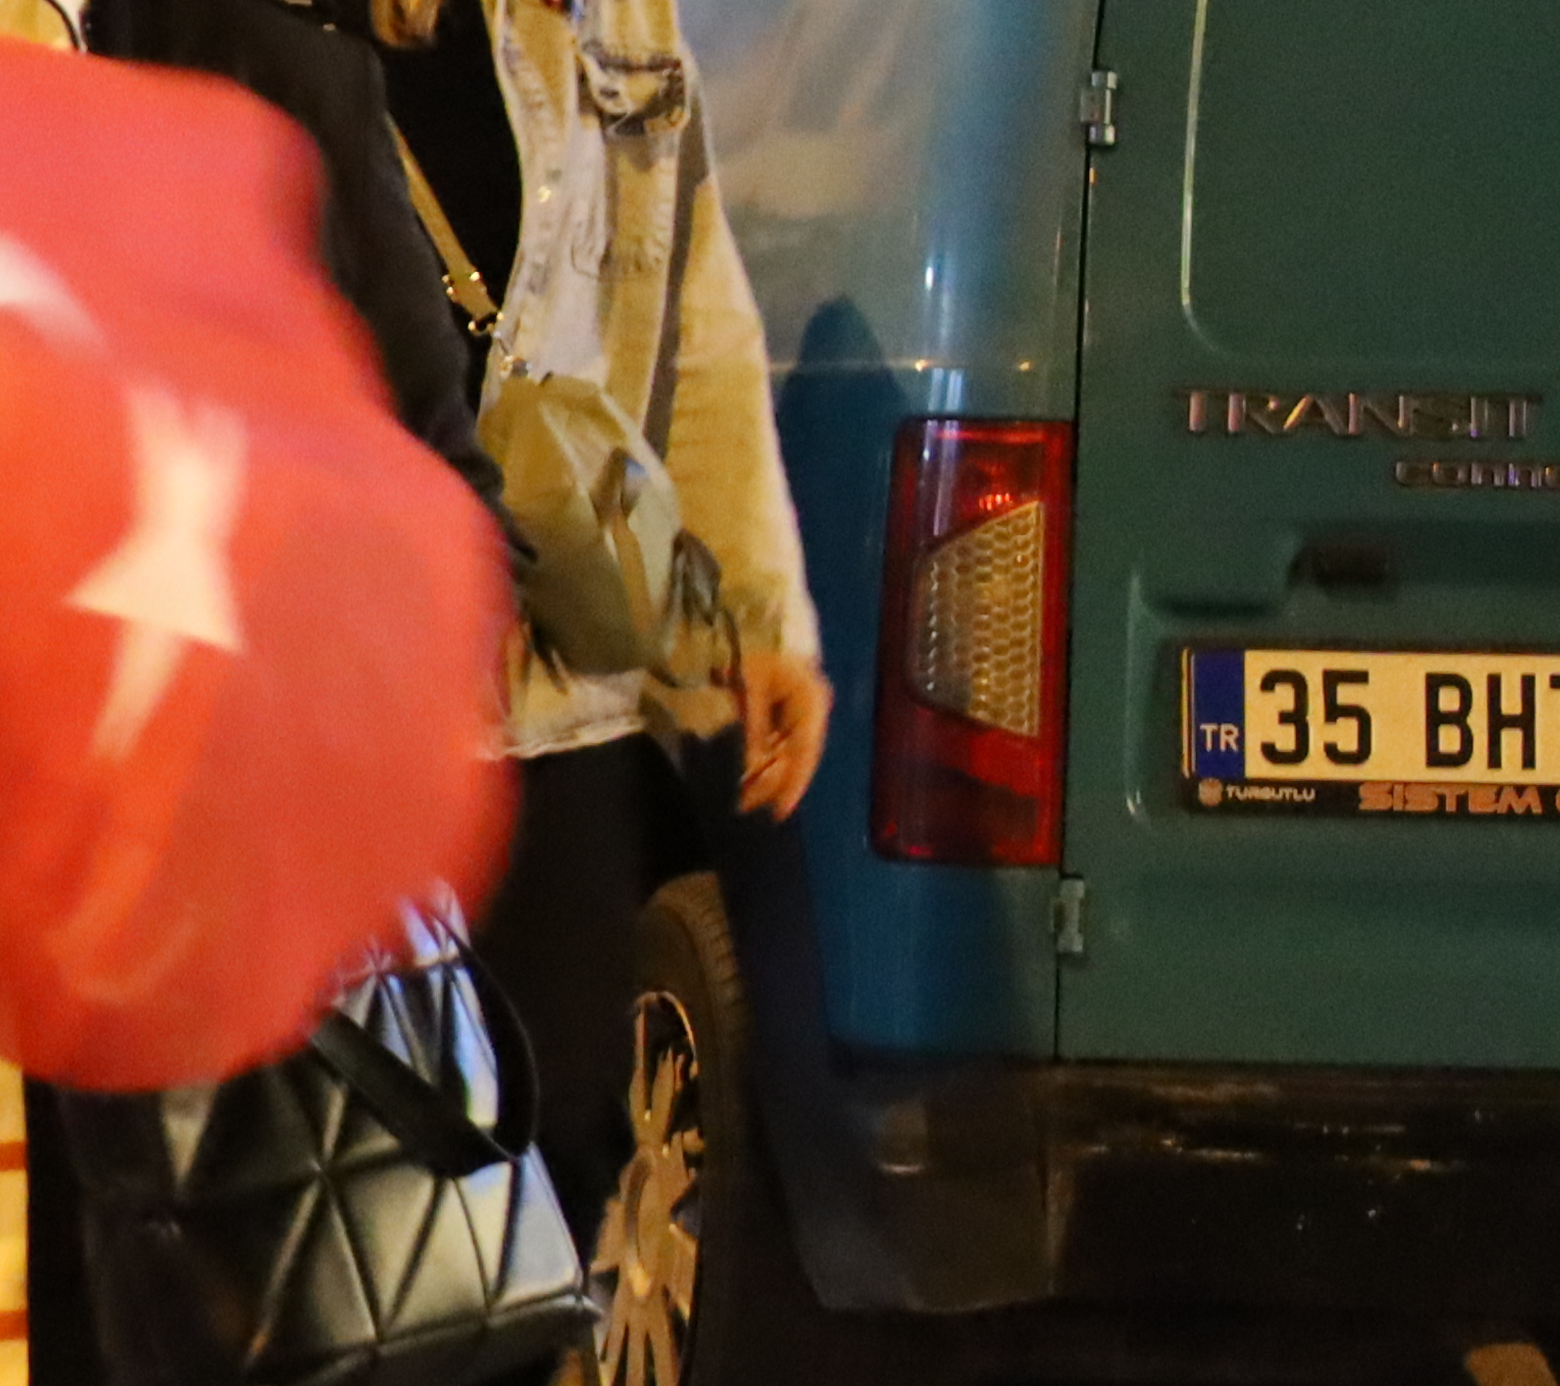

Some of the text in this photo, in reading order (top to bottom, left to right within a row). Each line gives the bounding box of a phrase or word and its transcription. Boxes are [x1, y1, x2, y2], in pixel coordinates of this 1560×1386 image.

[1177, 387, 1541, 439] TRANSIT
[1199, 722, 1240, 753] TR
[1259, 668, 1373, 766] 35
